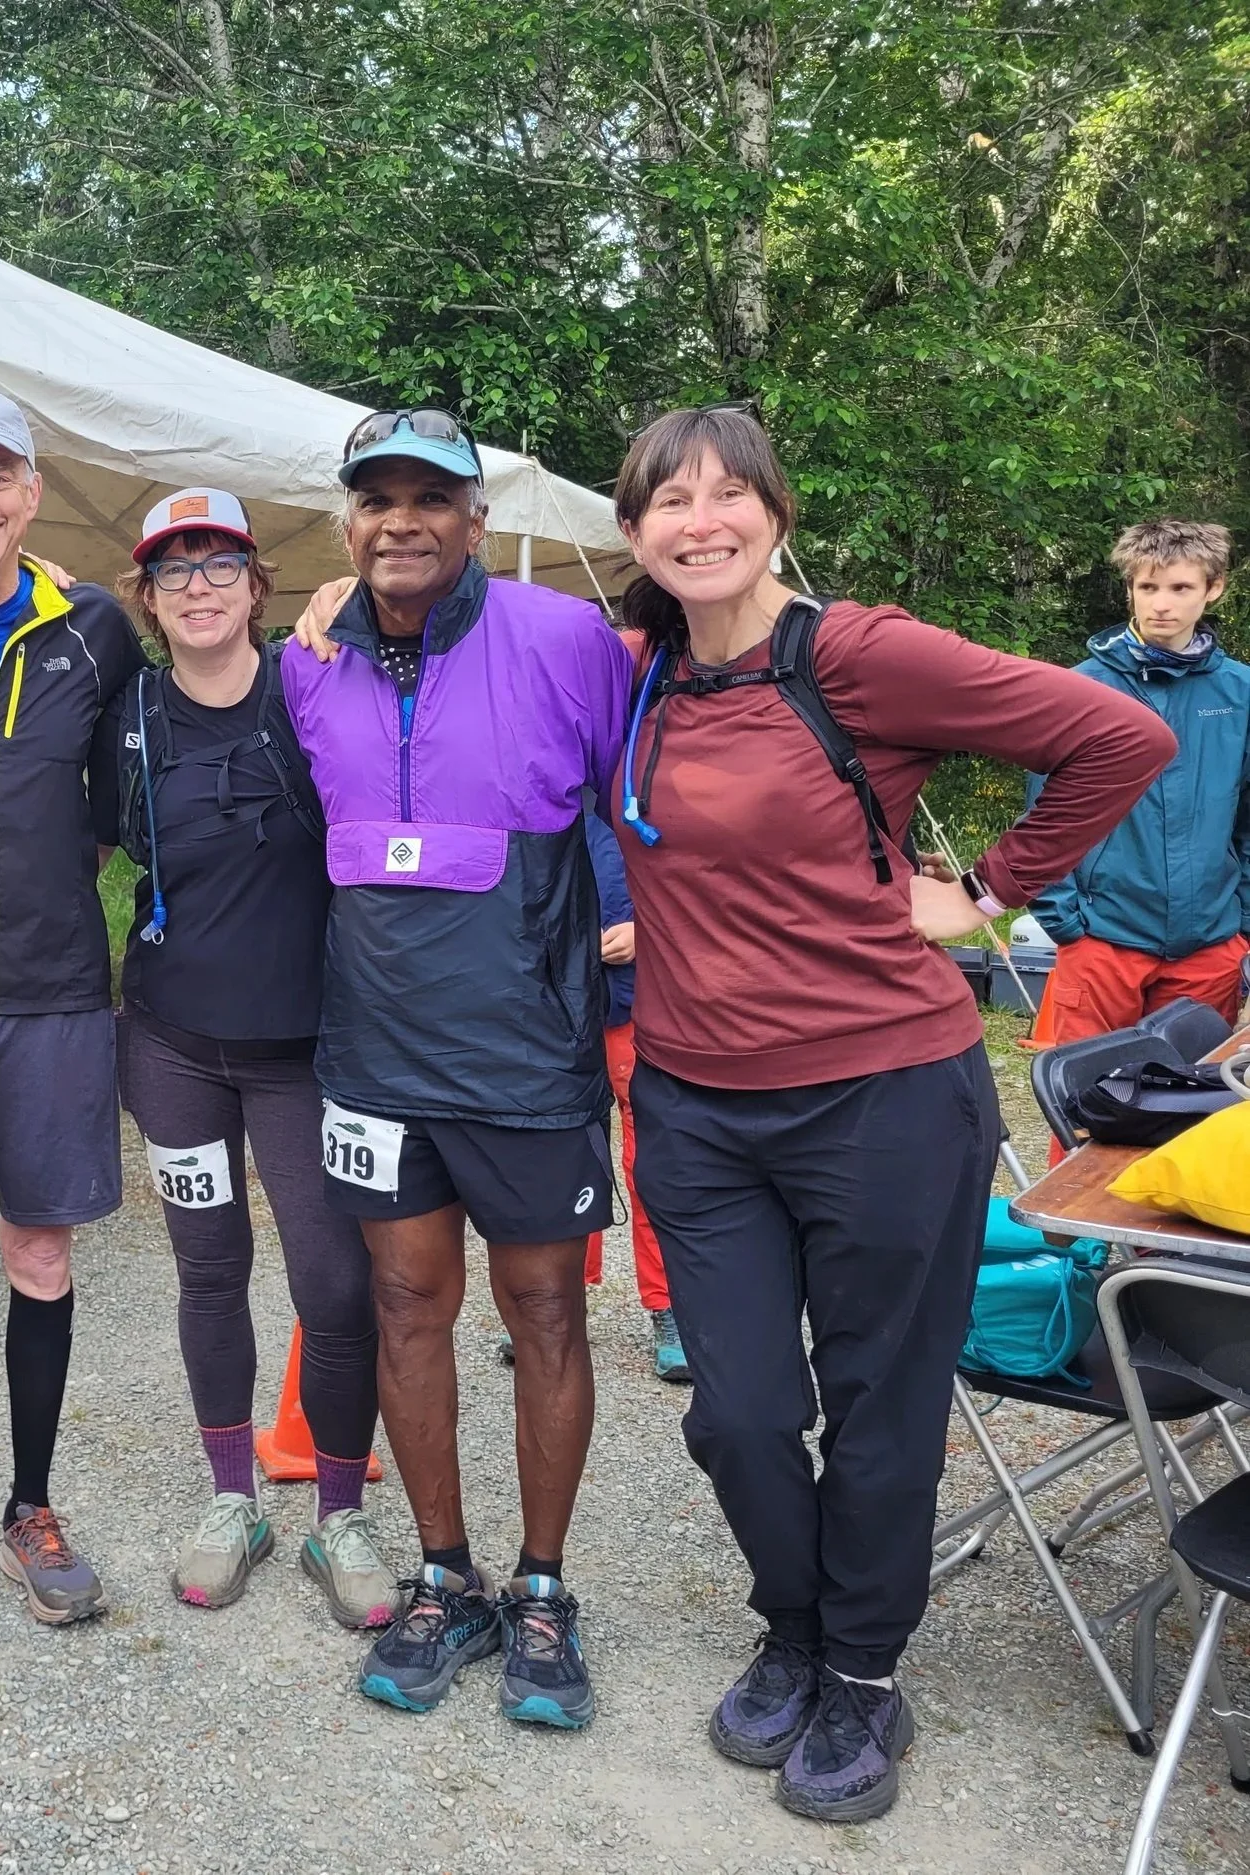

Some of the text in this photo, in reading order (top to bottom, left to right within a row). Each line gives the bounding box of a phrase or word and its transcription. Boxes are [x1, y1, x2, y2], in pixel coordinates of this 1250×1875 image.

[1197, 706, 1234, 717] Marmot
[326, 1130, 375, 1181] 319
[158, 1168, 215, 1204] 383
[444, 1614, 488, 1651] GORE-TE
